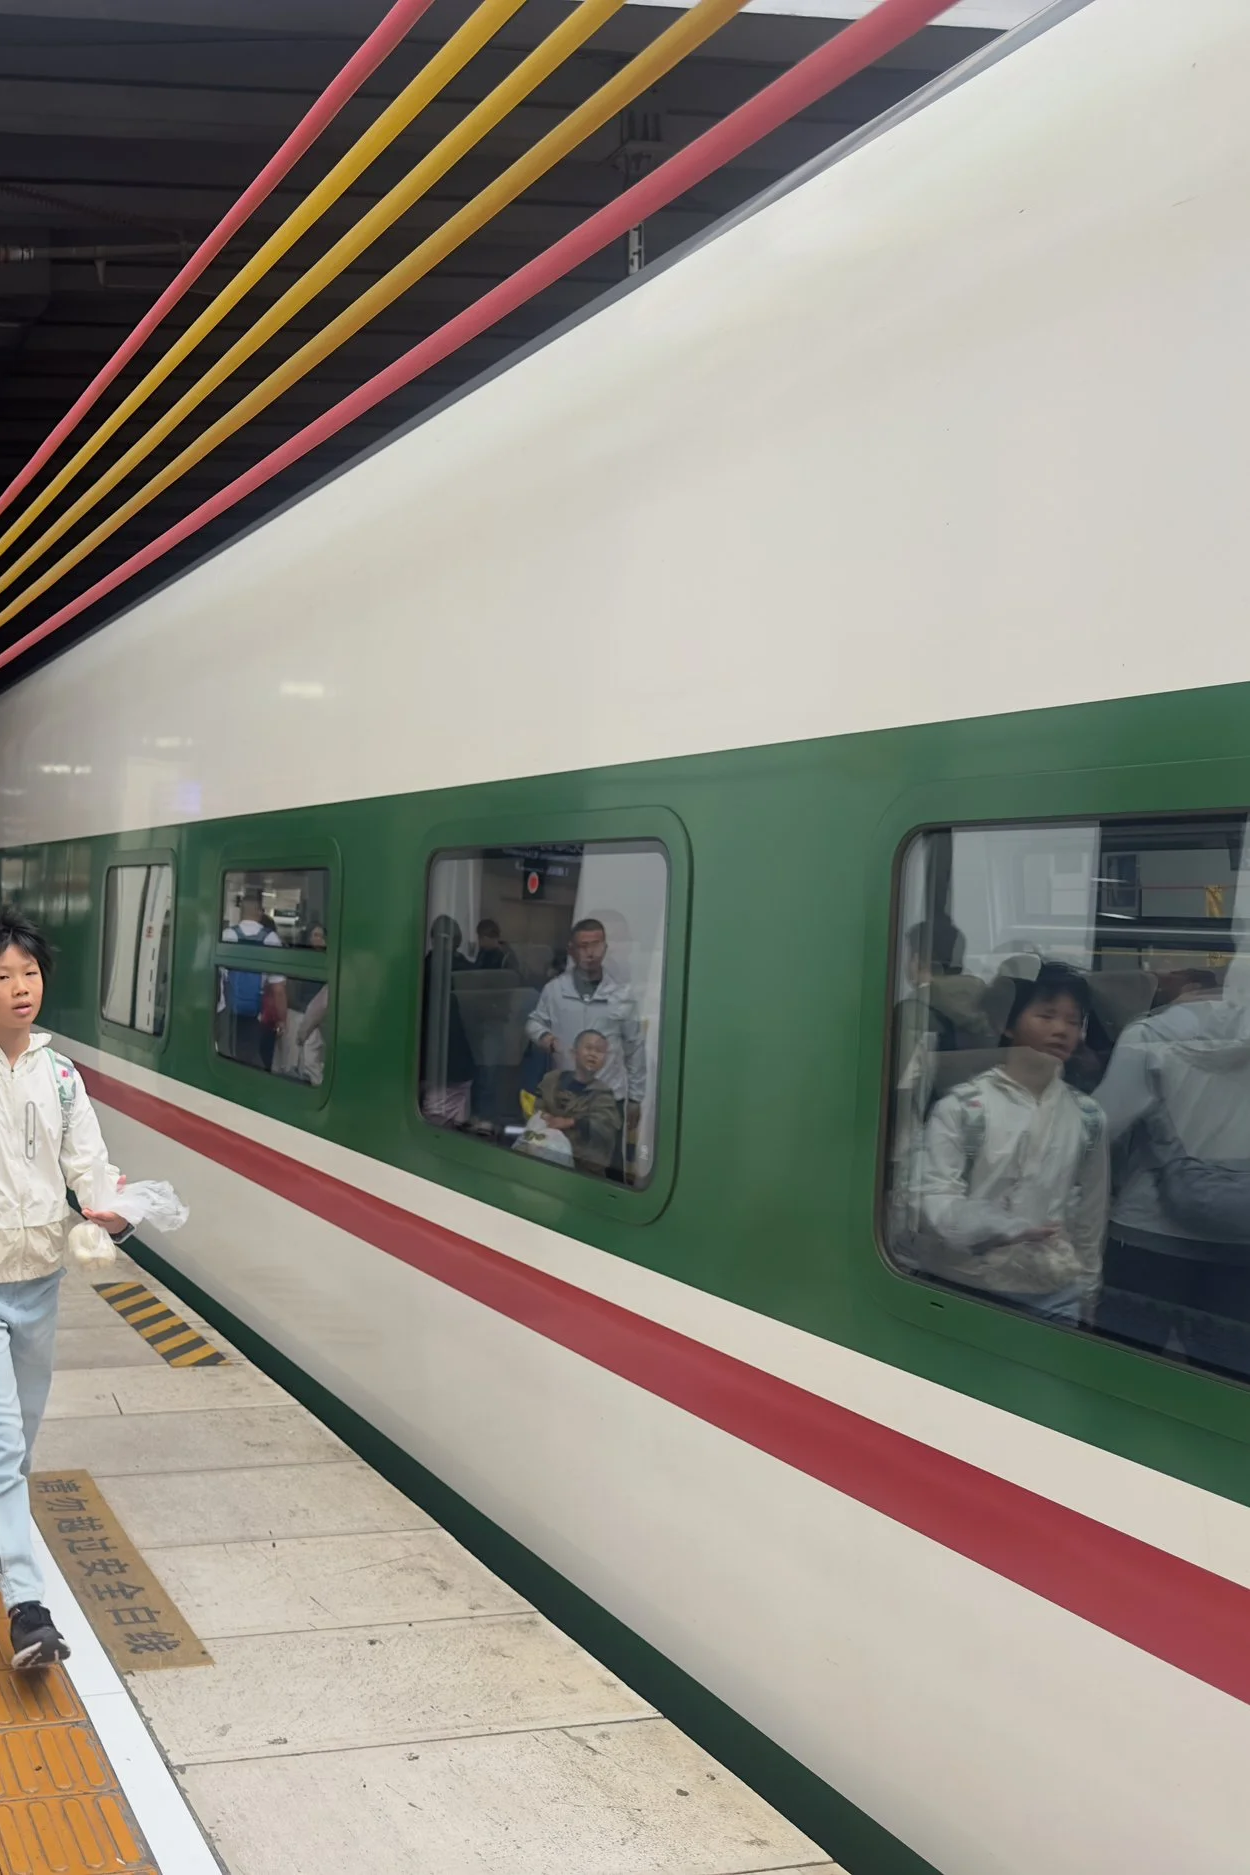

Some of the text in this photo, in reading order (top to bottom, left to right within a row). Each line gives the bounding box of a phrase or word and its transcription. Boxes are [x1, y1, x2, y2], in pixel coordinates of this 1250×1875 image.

[35, 1478, 184, 1655] 请勿越过安全白线
